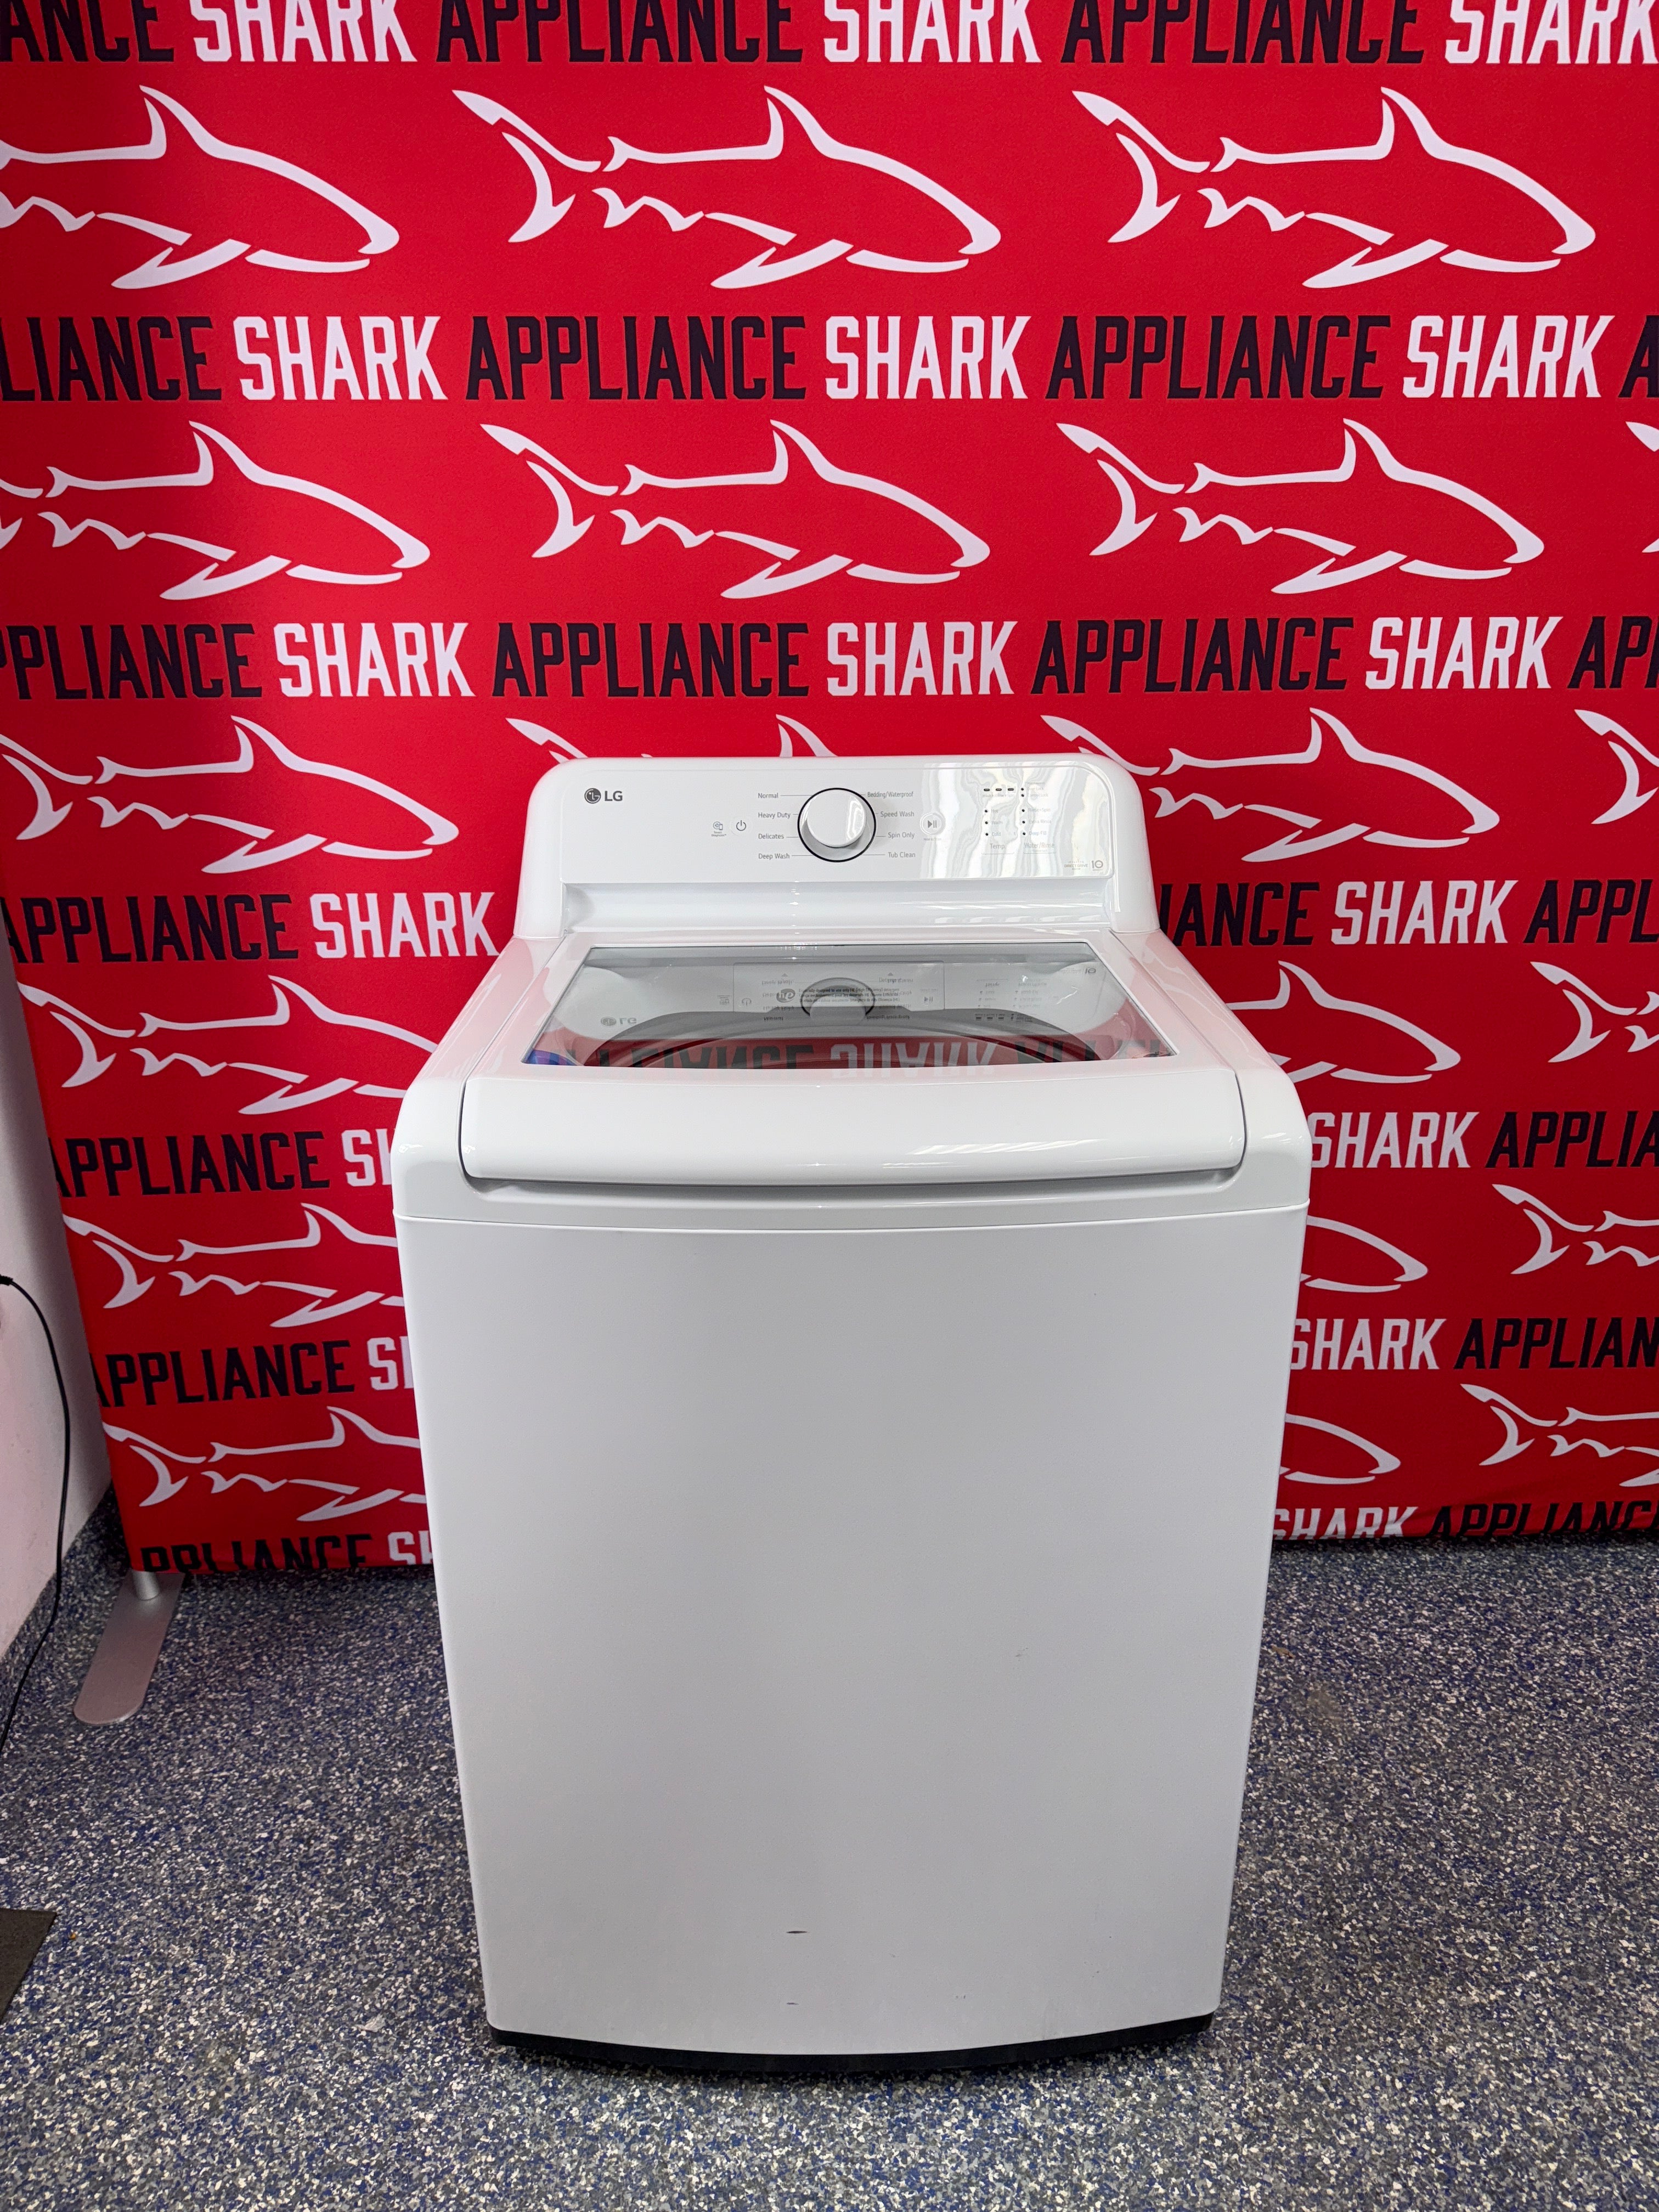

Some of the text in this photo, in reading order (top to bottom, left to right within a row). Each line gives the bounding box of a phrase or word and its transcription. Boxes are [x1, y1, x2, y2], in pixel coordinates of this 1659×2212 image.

[189, 0, 417, 62] SHARK
[436, 0, 803, 63] APPLIANCE
[823, 0, 1042, 63] SHARK
[1060, 0, 1424, 64] APPLIANCE
[1444, 0, 1659, 64] SHARK
[233, 316, 448, 400] SHARK
[465, 315, 806, 400] APPLIANCE
[825, 315, 1031, 399] SHARK
[1045, 315, 1391, 399] APPLIANCE
[1402, 315, 1615, 398] SHARK
[0, 623, 262, 700] PLIANCE
[273, 623, 475, 697] SHARK
[492, 623, 809, 697] APPLIANCE
[827, 621, 1018, 696] SHARK
[1030, 617, 1354, 694] APPLIANCE
[1365, 616, 1563, 690] SHARK
[605, 791, 623, 802] LG
[309, 892, 499, 958] SHARK
[1331, 880, 1518, 945] SHARK
[1522, 879, 1659, 944] APPL
[1308, 1111, 1479, 1168] SHARK
[1290, 1317, 1659, 1370] SHARK APPLIAN
[1428, 1500, 1659, 1536] APPLIANC
